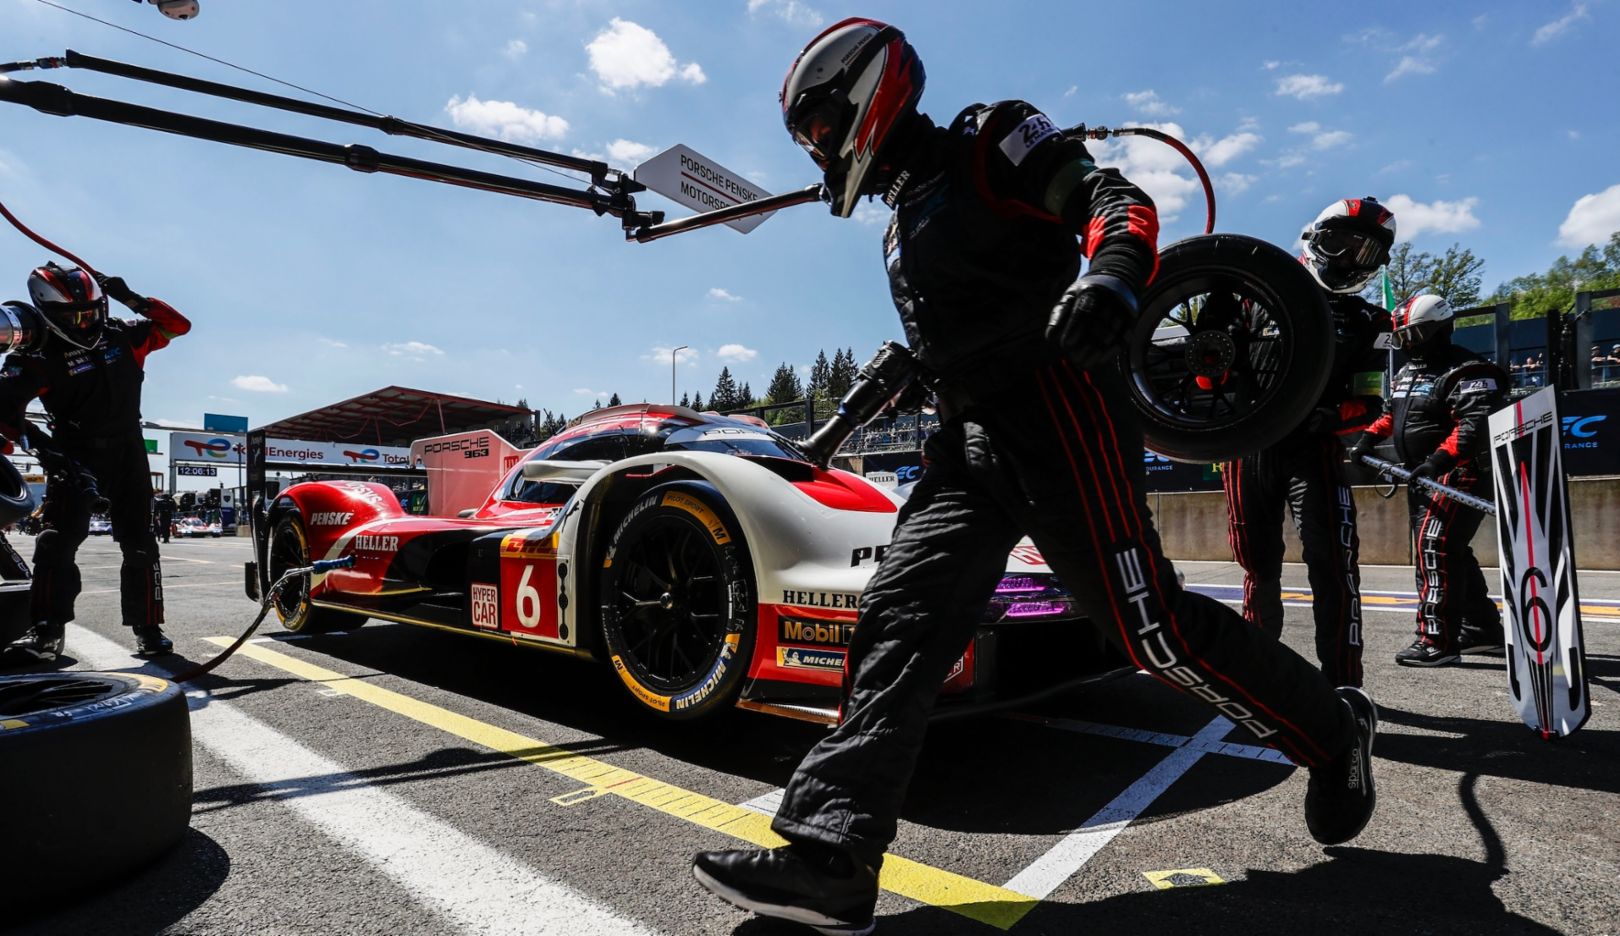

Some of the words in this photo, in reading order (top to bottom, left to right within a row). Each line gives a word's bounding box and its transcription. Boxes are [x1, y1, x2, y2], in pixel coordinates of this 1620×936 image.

[681, 154, 725, 189] PORSCHE
[725, 178, 758, 201] PENSKE
[1494, 411, 1553, 445] PORSCHE
[424, 437, 489, 455] PORSCHE
[464, 448, 489, 459] 963
[180, 467, 216, 476] 12:06:13
[310, 512, 354, 526] PENSKE
[613, 495, 658, 544] MICHELIN
[356, 535, 398, 552] HELLER
[712, 527, 726, 540] M
[1424, 519, 1442, 635] PORSCHE
[473, 586, 496, 604] HYPER
[516, 565, 541, 628] 6
[783, 590, 859, 608] HELLER
[473, 601, 497, 626] CAR
[1520, 566, 1553, 653] 6
[784, 621, 840, 643] Mobil
[1116, 547, 1278, 739] PORSCHE
[803, 656, 845, 667] MICHE
[676, 660, 727, 710] MICHELIN
[1347, 748, 1359, 789] sparco
